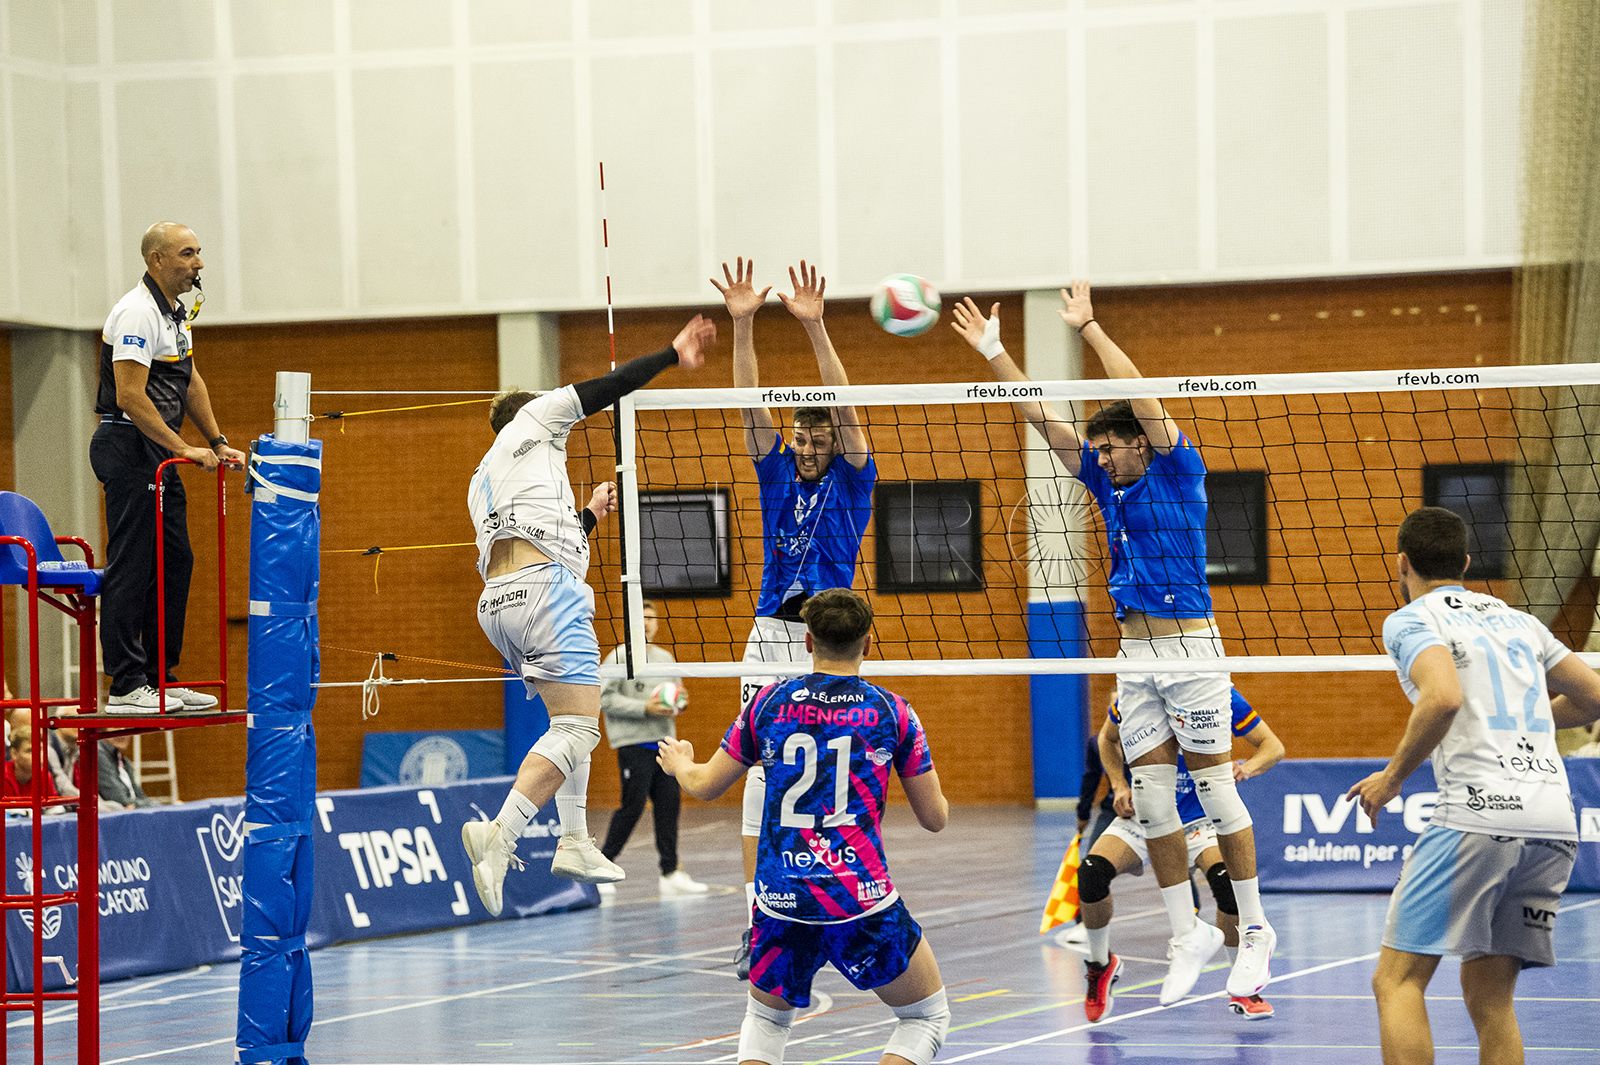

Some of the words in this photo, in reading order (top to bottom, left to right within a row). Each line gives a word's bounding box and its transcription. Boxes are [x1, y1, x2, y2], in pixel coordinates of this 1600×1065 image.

[1178, 378, 1257, 392] rfevb.com
[1397, 372, 1480, 386] rfevb.com
[762, 390, 836, 402] rfevb.com
[966, 385, 1043, 398] rfevb.com
[743, 683, 763, 703] 87
[1473, 636, 1550, 733] 12
[1124, 725, 1158, 749] MELILLA
[780, 732, 857, 829] 21
[339, 826, 447, 889] TIPSA
[1364, 843, 1398, 869] per
[768, 892, 796, 900] SOLAR
[768, 900, 797, 909] VISION
